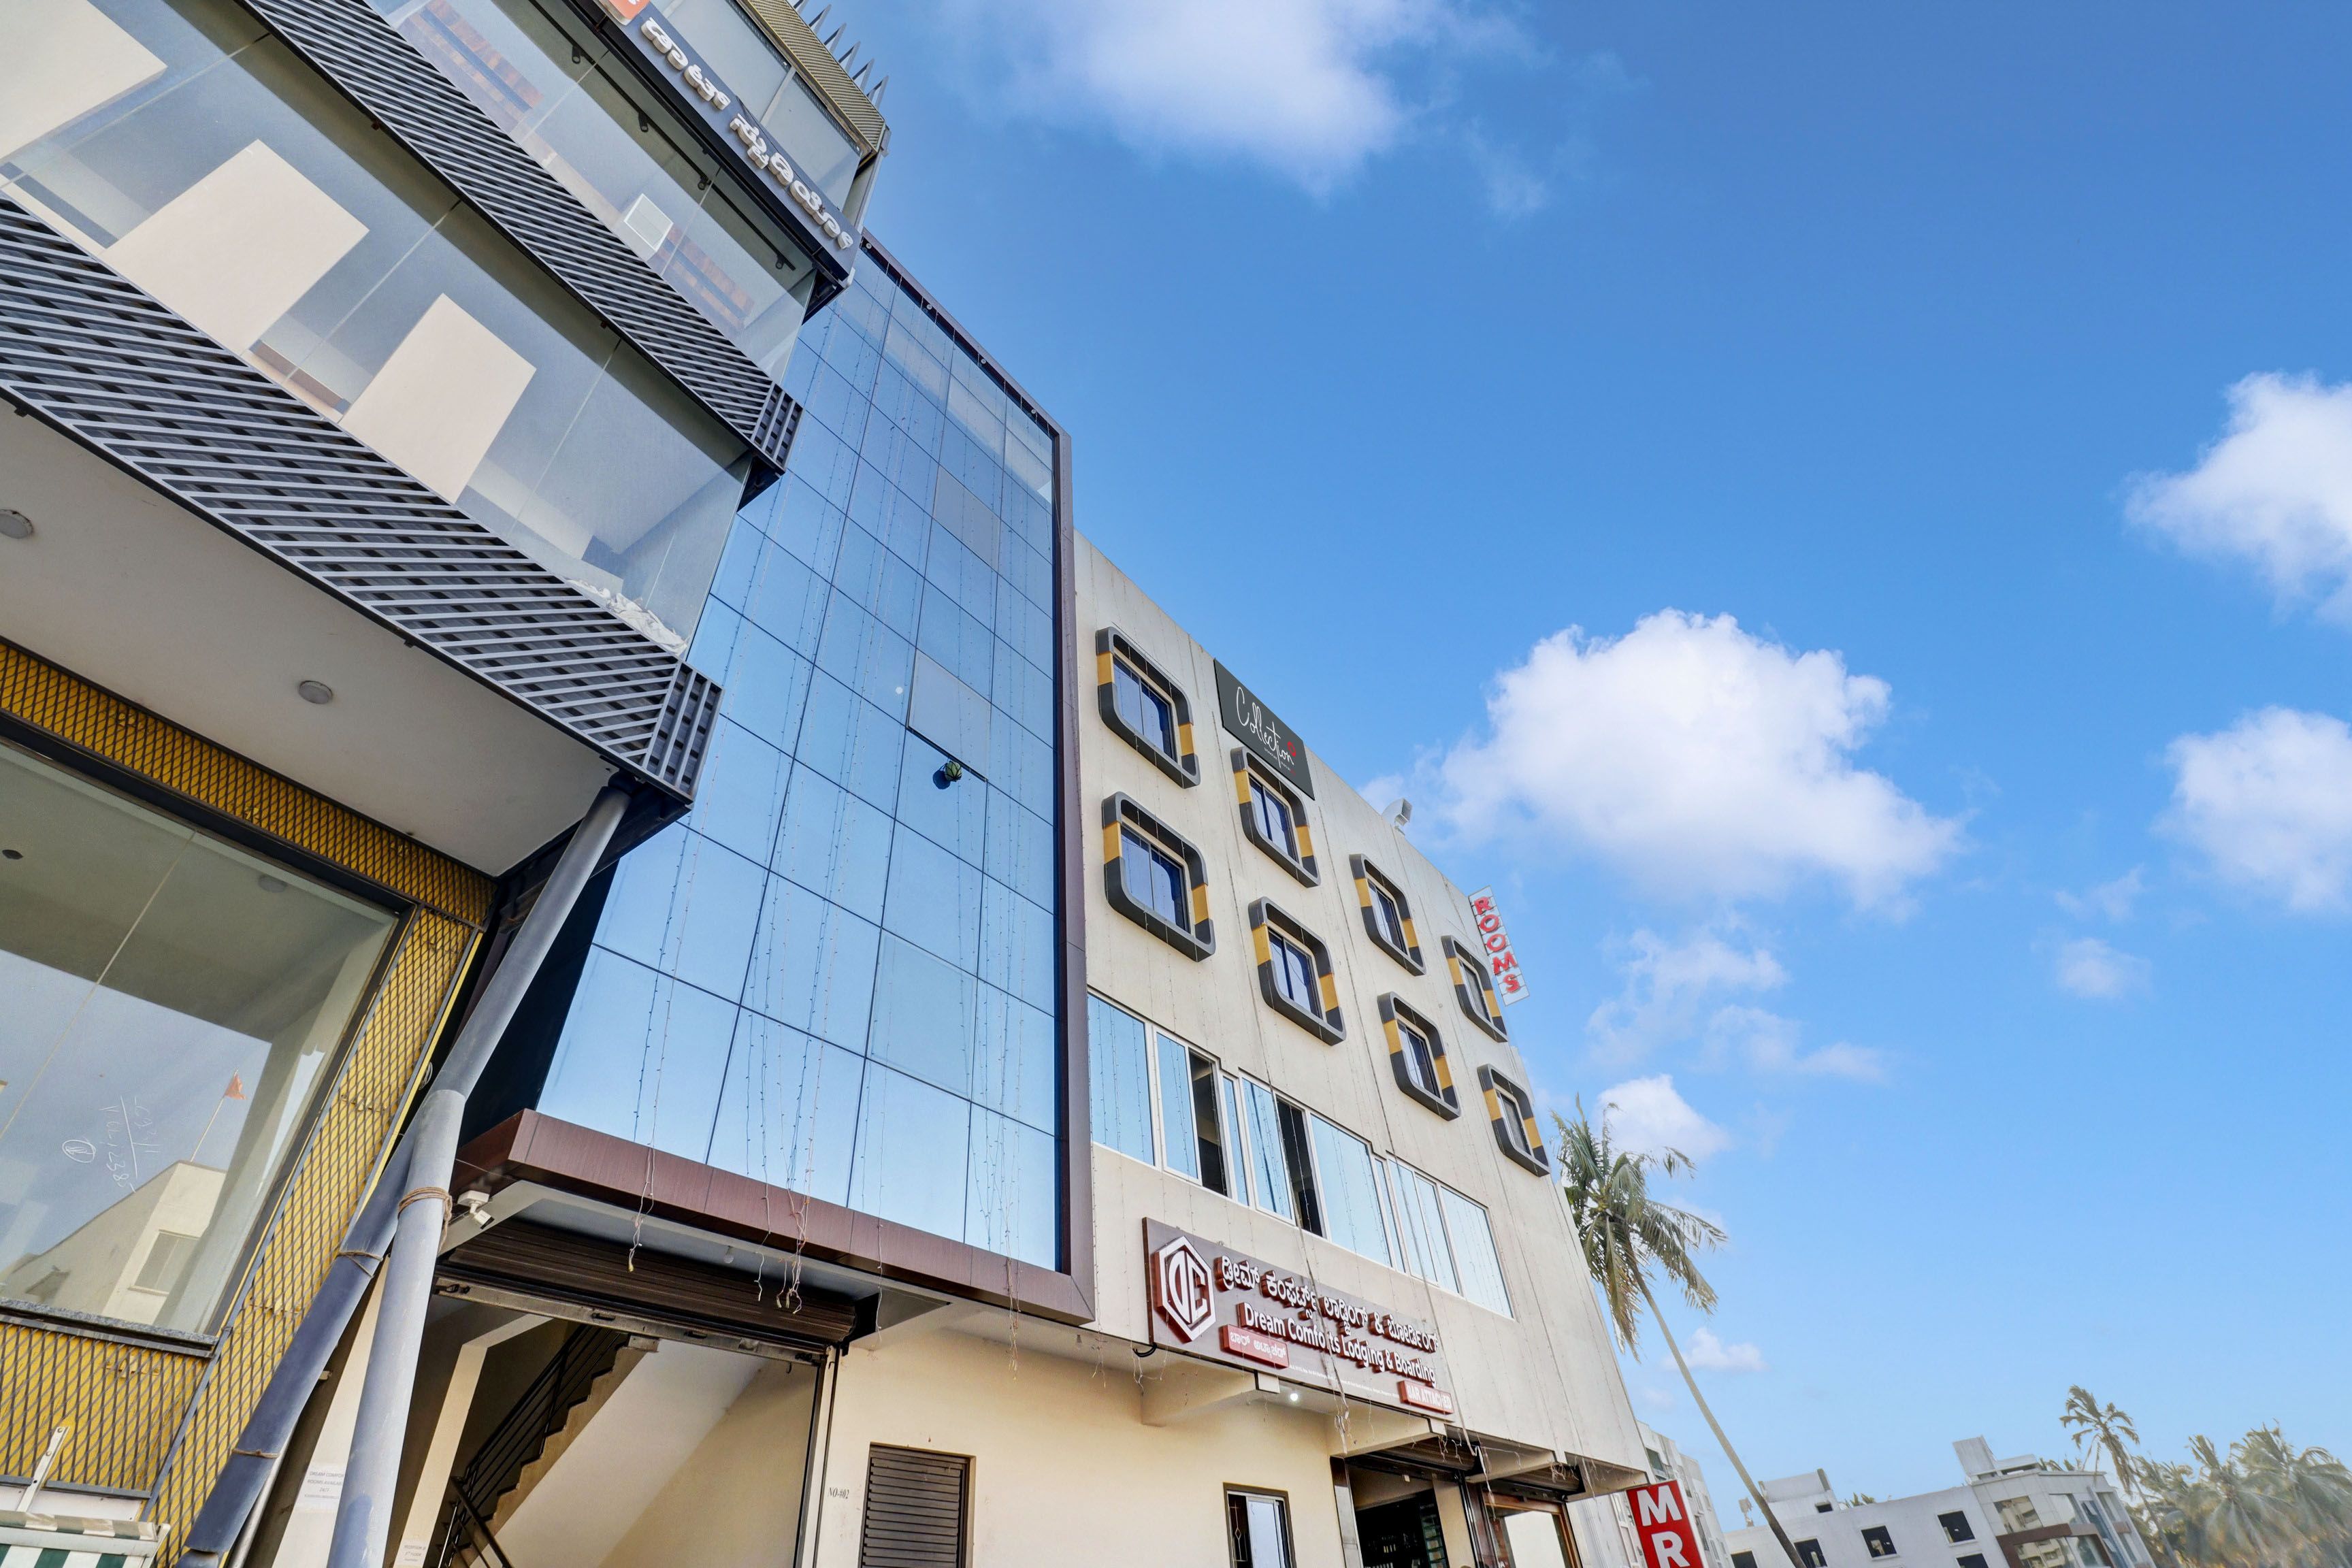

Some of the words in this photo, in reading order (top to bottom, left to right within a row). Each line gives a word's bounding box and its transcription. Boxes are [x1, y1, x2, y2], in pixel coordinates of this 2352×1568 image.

[1236, 686, 1294, 768] Collection
[1473, 896, 1520, 993] ROOMS
[1244, 1303, 1286, 1337] Dream
[1341, 1335, 1384, 1373] Lodging
[1385, 1350, 1394, 1370] &
[1394, 1352, 1437, 1388] Boarding
[1373, 1311, 1385, 1334] &
[1406, 1384, 1422, 1402] BAR
